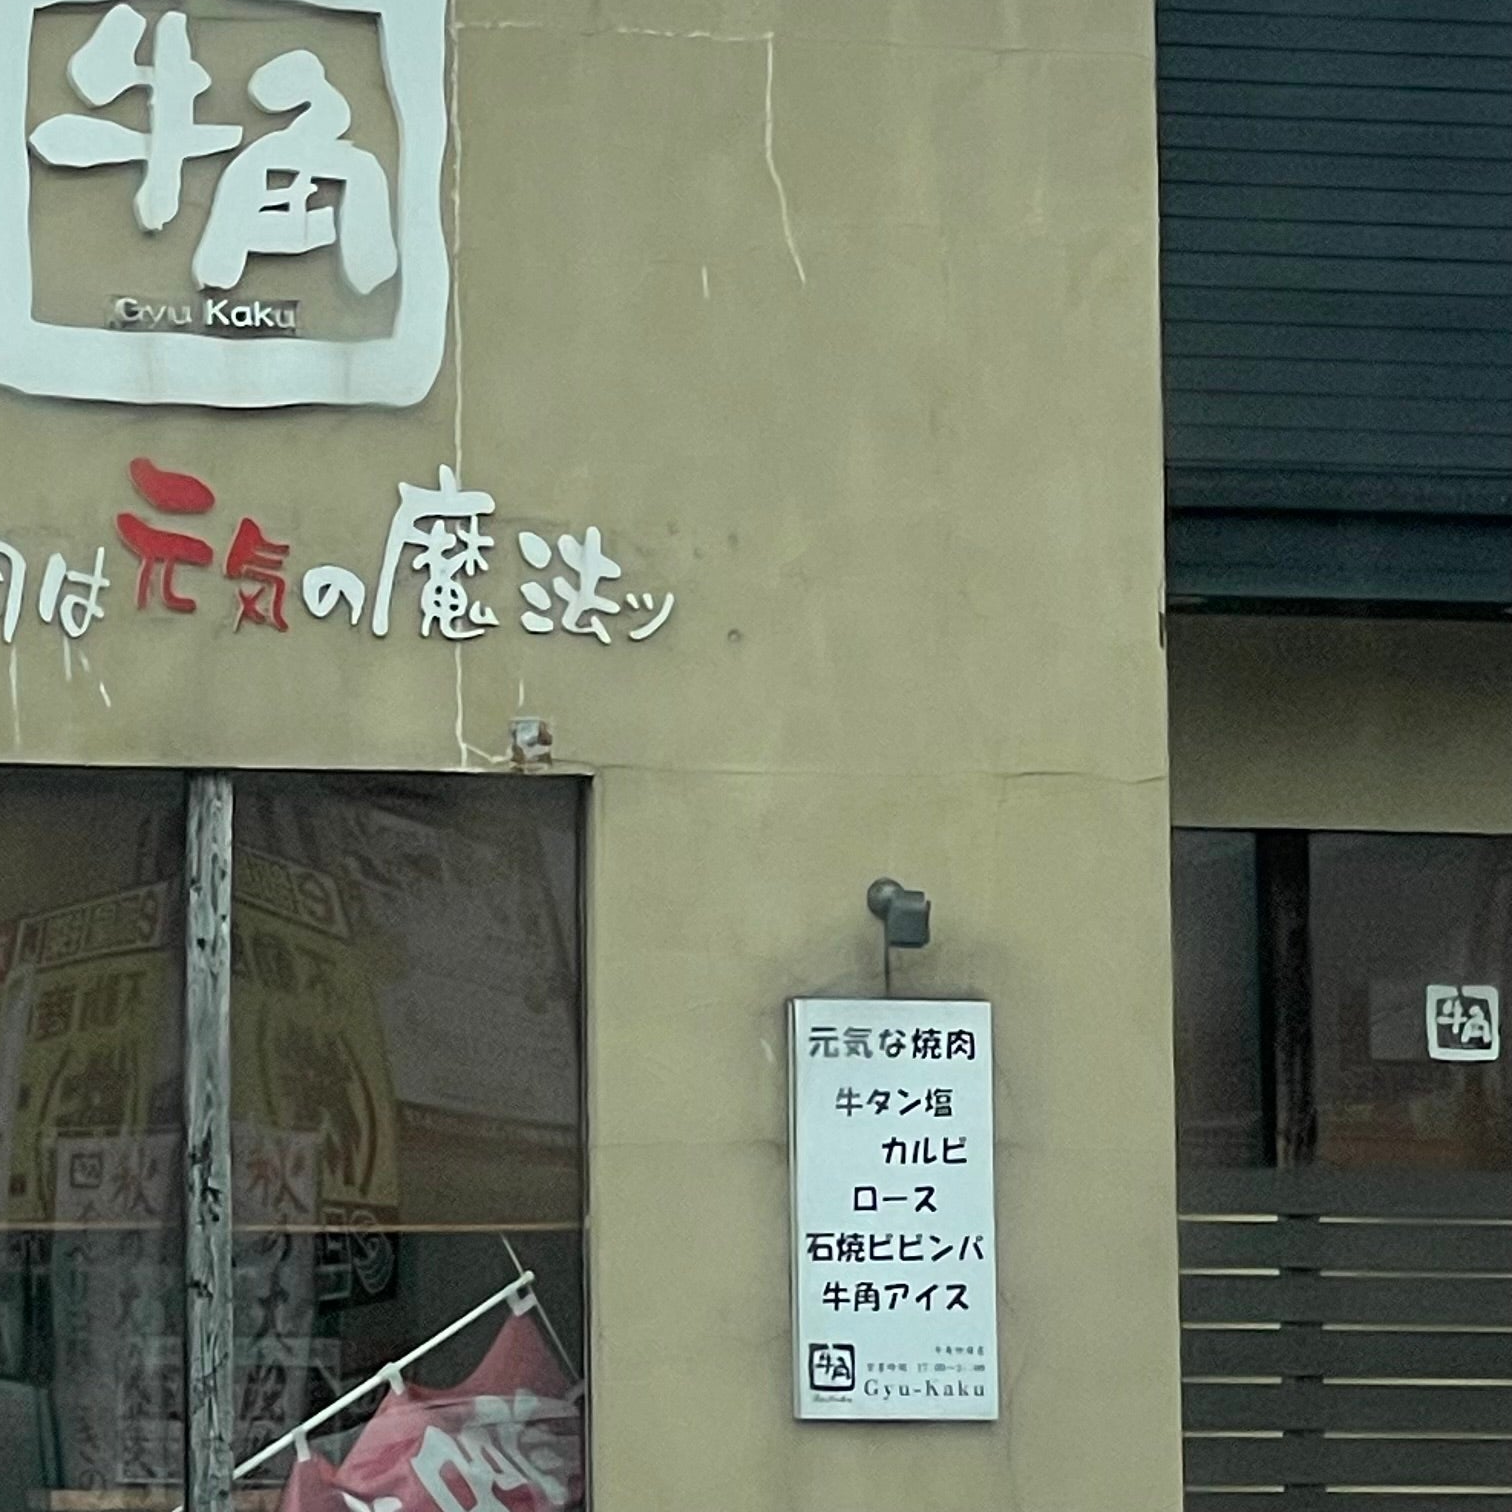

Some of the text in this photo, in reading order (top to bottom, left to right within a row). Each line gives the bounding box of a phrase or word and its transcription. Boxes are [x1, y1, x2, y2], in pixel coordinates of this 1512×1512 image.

[29, 3, 399, 295] 牛角
[114, 296, 297, 329] Gyu Kaku
[1436, 997, 1493, 1044] 牛角
[808, 1026, 976, 1061] 元気な焼肉
[835, 1086, 954, 1118] 牛タン塩
[881, 1136, 968, 1165] カルビ
[853, 1185, 938, 1213] ロース
[822, 1280, 970, 1312] 牛角アイス
[815, 1351, 852, 1381] 牛角
[863, 1378, 985, 1401] Gyu-Kaku
